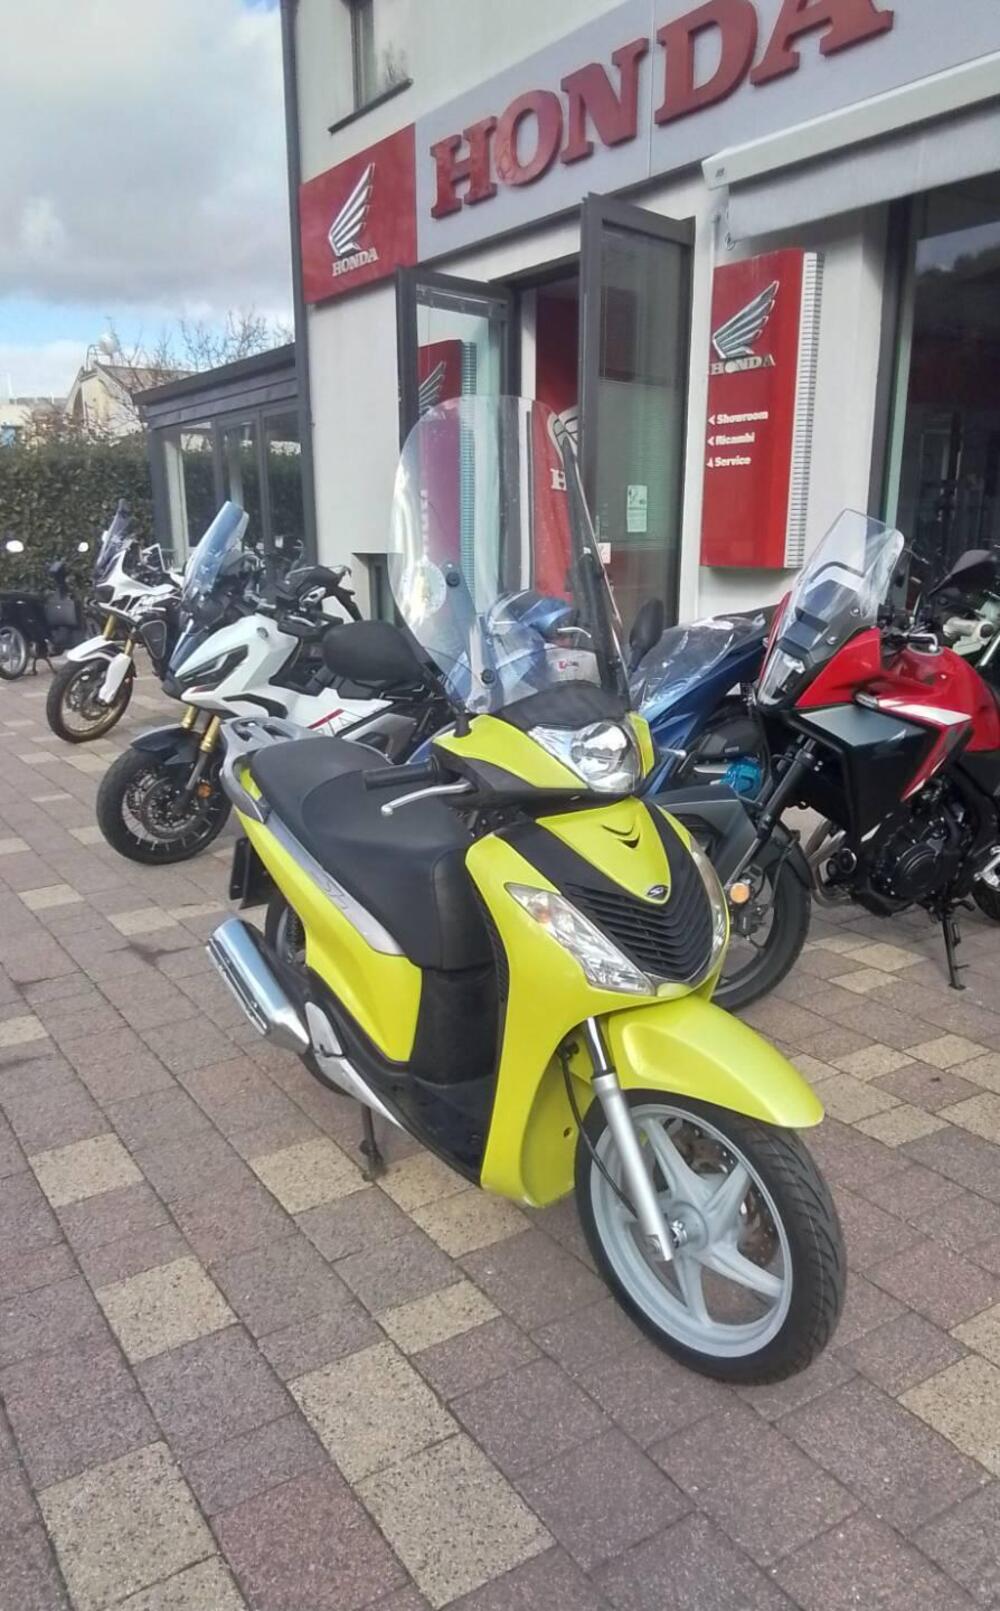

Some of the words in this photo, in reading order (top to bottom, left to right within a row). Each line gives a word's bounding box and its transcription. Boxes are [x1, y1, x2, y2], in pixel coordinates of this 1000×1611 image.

[429, 0, 895, 220] HONDA
[332, 247, 379, 277] HONDA
[710, 353, 776, 375] HONDA
[716, 411, 769, 425] Showroom
[714, 455, 752, 467] Service
